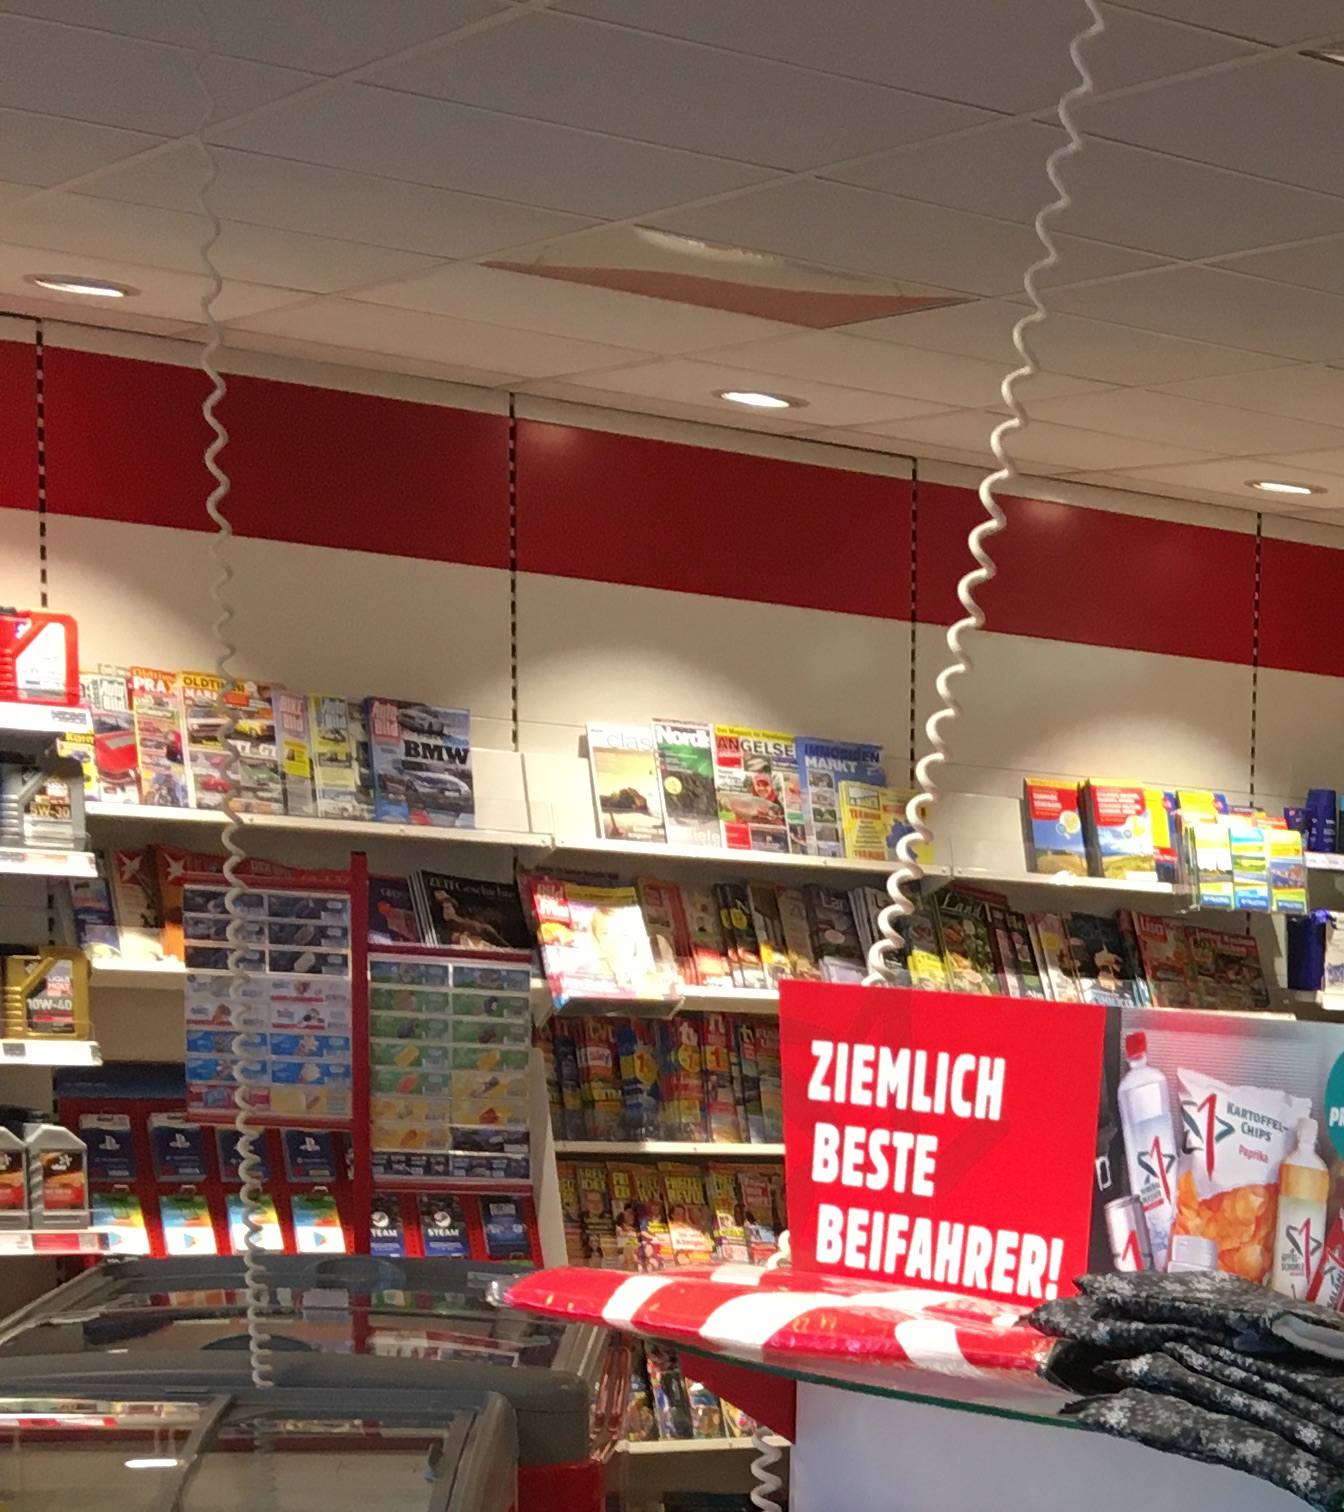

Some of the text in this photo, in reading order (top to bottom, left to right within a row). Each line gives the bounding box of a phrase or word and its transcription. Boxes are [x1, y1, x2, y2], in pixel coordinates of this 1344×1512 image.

[404, 740, 469, 765] BMW
[804, 756, 858, 774] MARKT
[27, 998, 73, 1011] 10W-40
[808, 1041, 1006, 1121] ZIEMLICH
[1226, 1102, 1289, 1132] KARTOFFEL-
[812, 1123, 938, 1199] BESTE
[1238, 1144, 1269, 1164] Paprika
[428, 1226, 460, 1239] STEAM
[815, 1204, 1064, 1301] BEIFAHRER!
